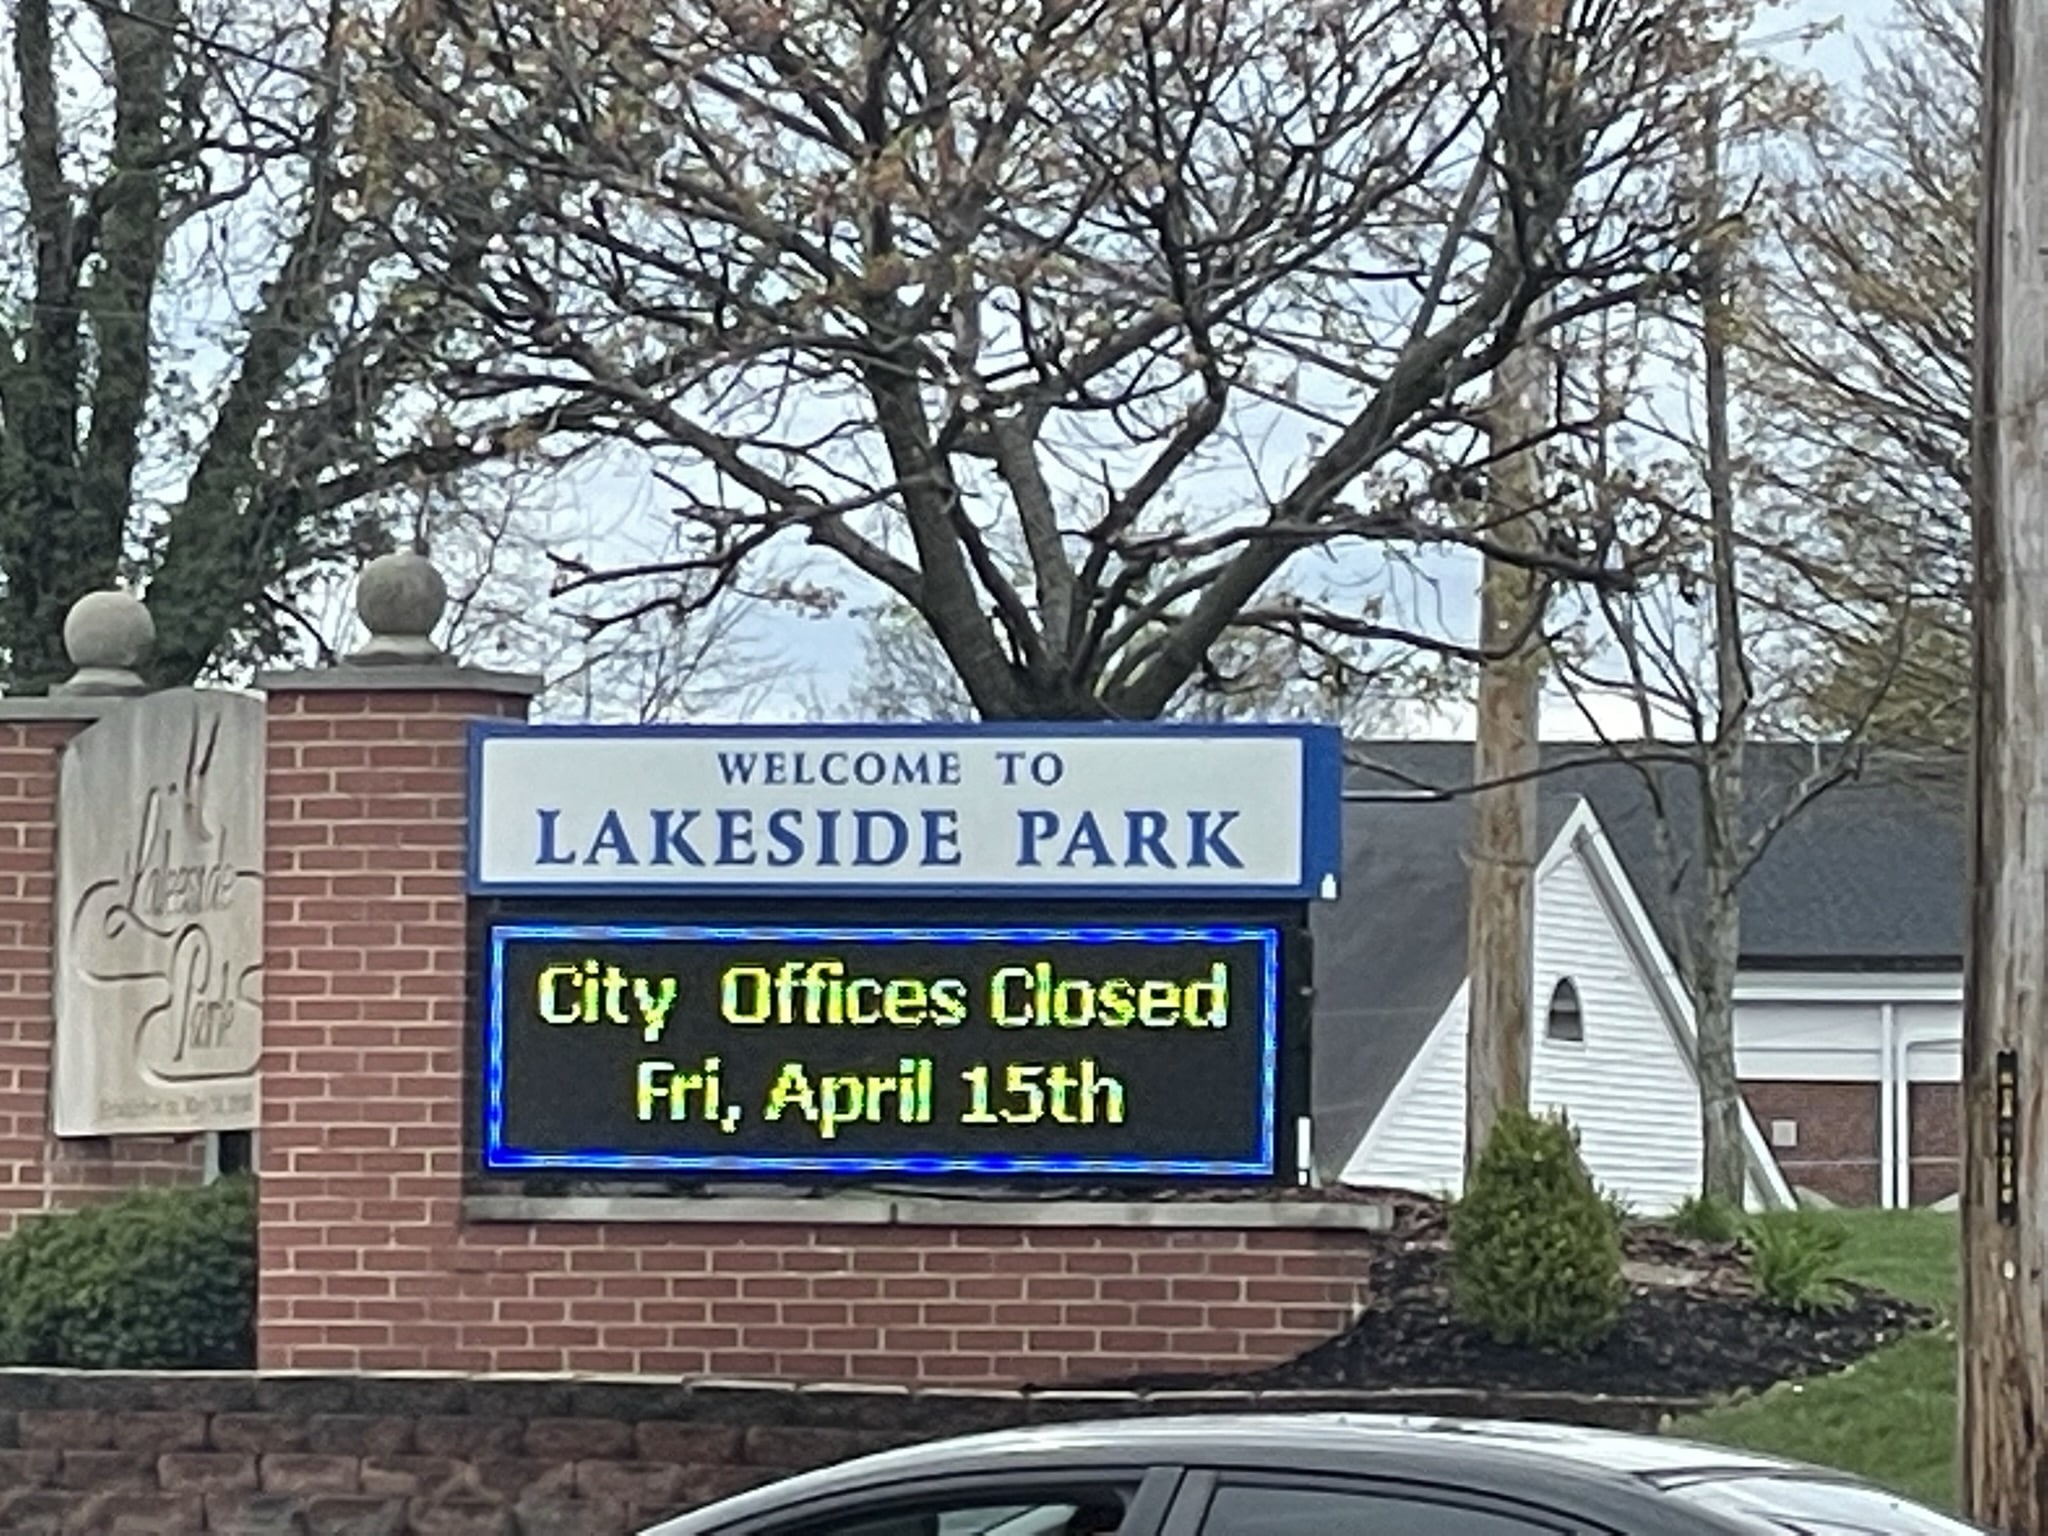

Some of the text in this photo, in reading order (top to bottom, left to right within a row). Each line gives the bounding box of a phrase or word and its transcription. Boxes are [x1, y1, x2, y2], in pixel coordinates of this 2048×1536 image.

[718, 752, 1064, 786] WELCOME TO
[535, 809, 1244, 869] LAKESIDE PARK
[538, 959, 1229, 1042] City Offices Closed
[636, 1057, 1124, 1138] Fri, April 15th
